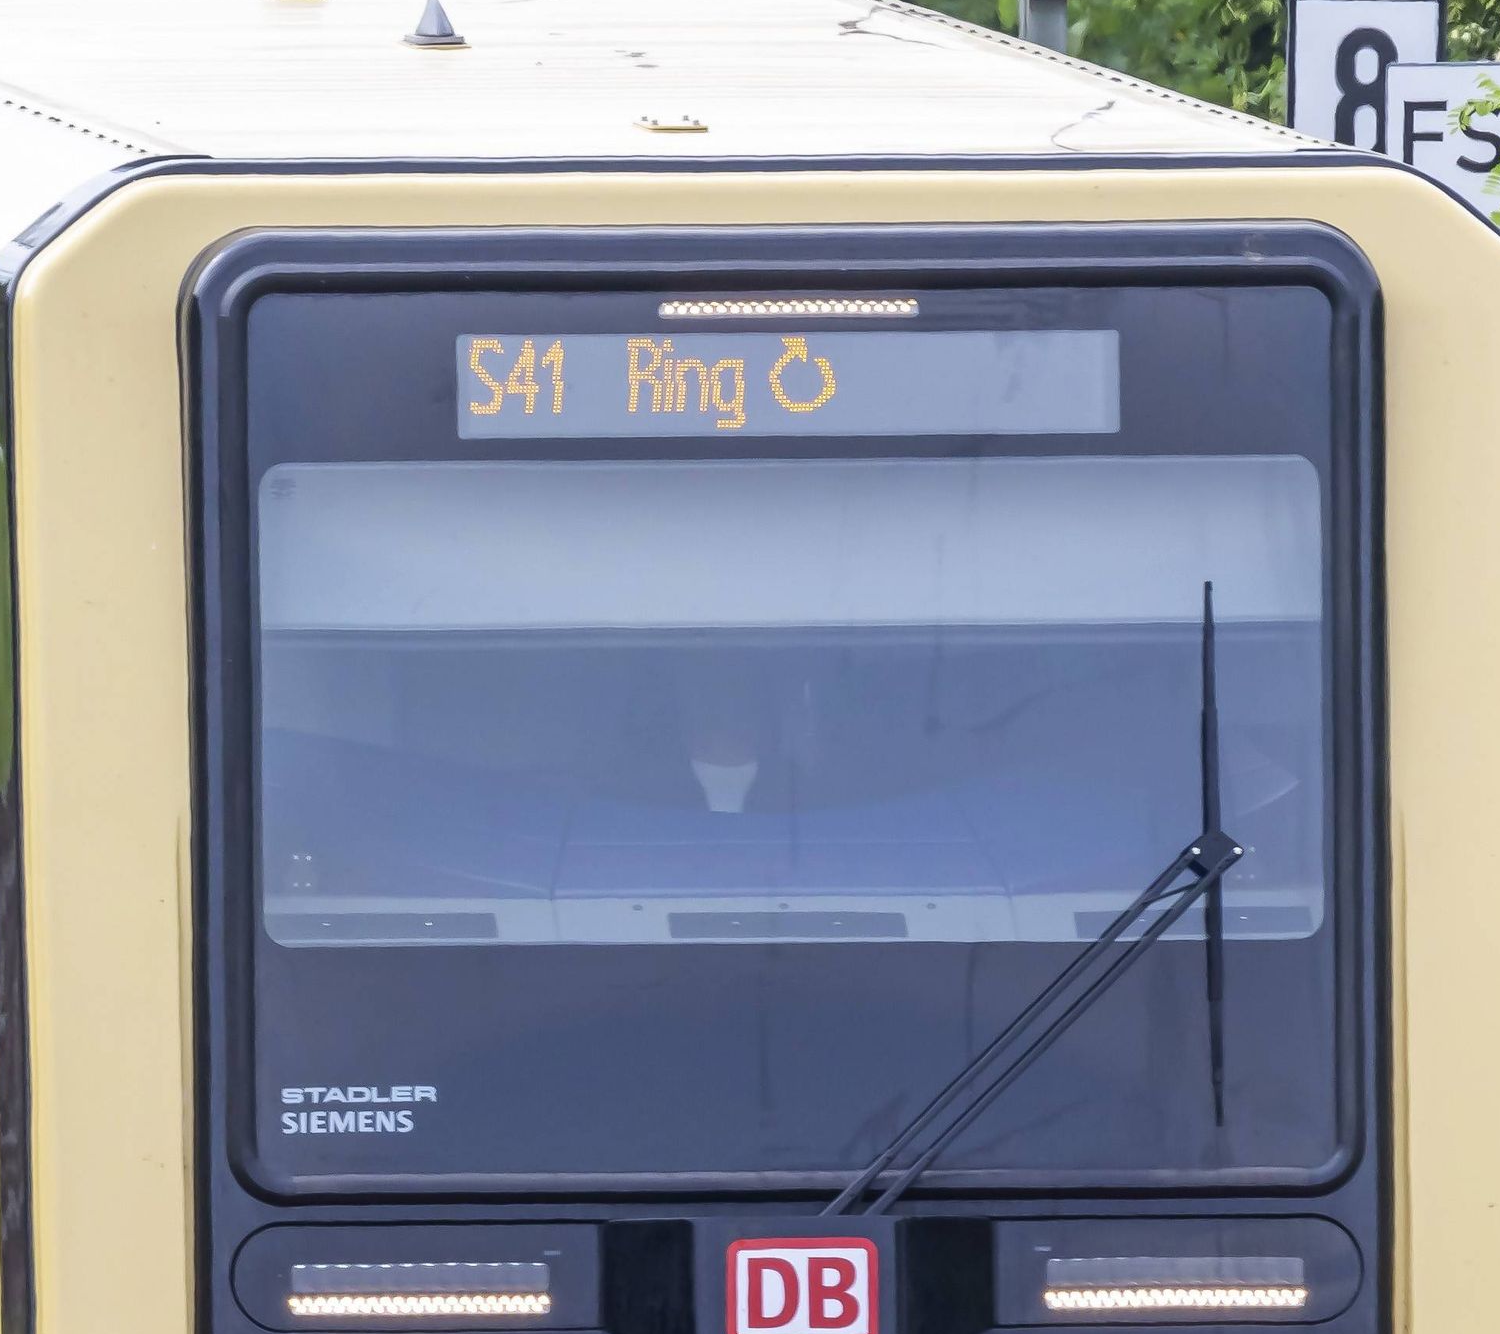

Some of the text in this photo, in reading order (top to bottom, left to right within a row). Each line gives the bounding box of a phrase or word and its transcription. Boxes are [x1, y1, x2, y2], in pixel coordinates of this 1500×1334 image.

[468, 338, 746, 430] S41 Ring
[280, 1085, 438, 1104] STADLER
[280, 1110, 415, 1134] SIEMENS
[745, 1254, 862, 1331] DB
